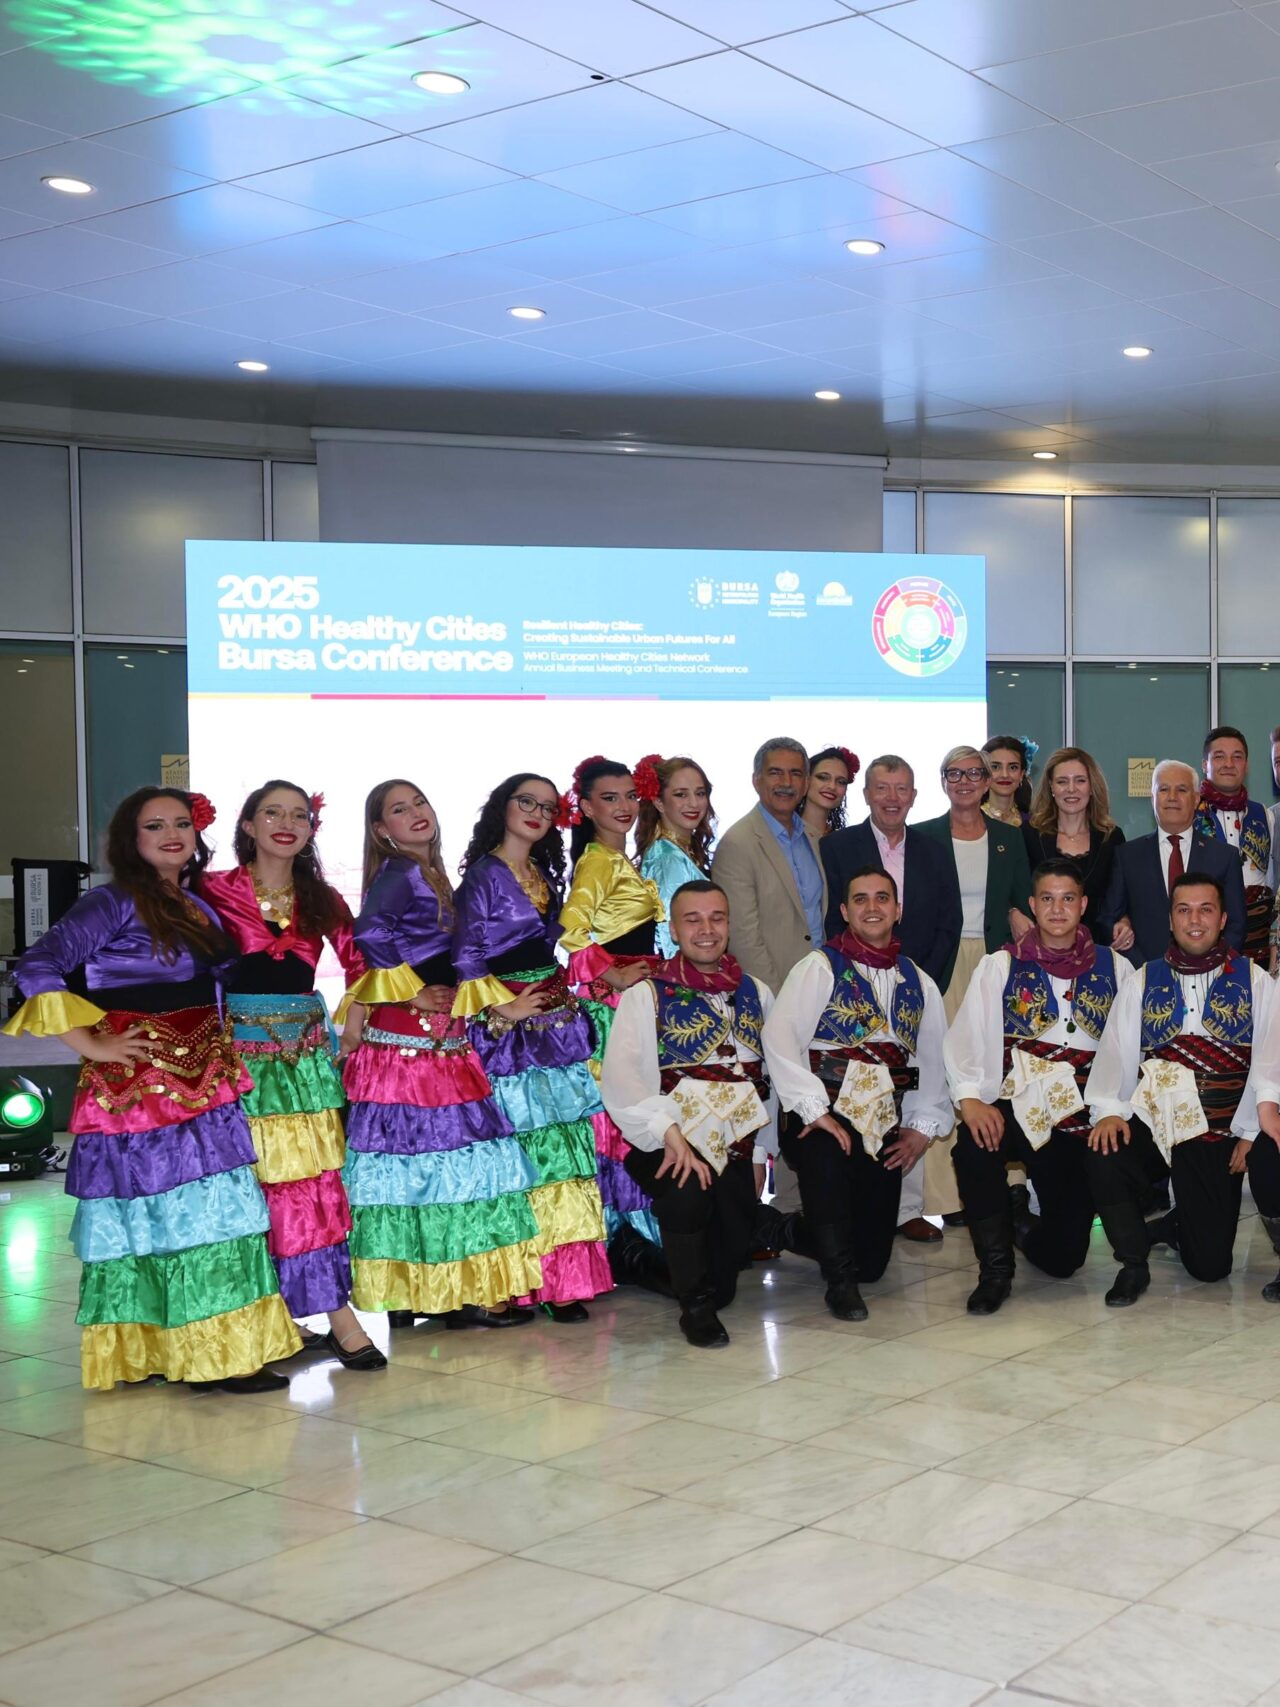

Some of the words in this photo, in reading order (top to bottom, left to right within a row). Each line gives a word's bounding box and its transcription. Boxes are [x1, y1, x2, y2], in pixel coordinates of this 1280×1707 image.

[217, 575, 320, 610] 2025
[218, 613, 302, 640] WHO
[309, 614, 421, 647] Healthy
[425, 615, 507, 641] Cities
[523, 620, 568, 631] Resilient
[568, 620, 609, 632] Healthy
[523, 632, 569, 645] Creating
[570, 633, 631, 643] Sustainable
[632, 633, 663, 644] Urban
[665, 634, 703, 644] Futures
[704, 634, 721, 644] For
[721, 634, 736, 644] All
[218, 641, 316, 670] Bursa
[321, 642, 514, 671] Conference
[523, 651, 549, 661] WHO
[550, 651, 599, 663] European
[600, 651, 640, 663] Healthy
[640, 652, 668, 662] Cities
[670, 652, 711, 662] Network
[523, 663, 556, 673] Annual
[596, 664, 632, 675] Meeting
[633, 664, 652, 673] and
[653, 664, 695, 673] Technical
[696, 665, 748, 674] Conference
